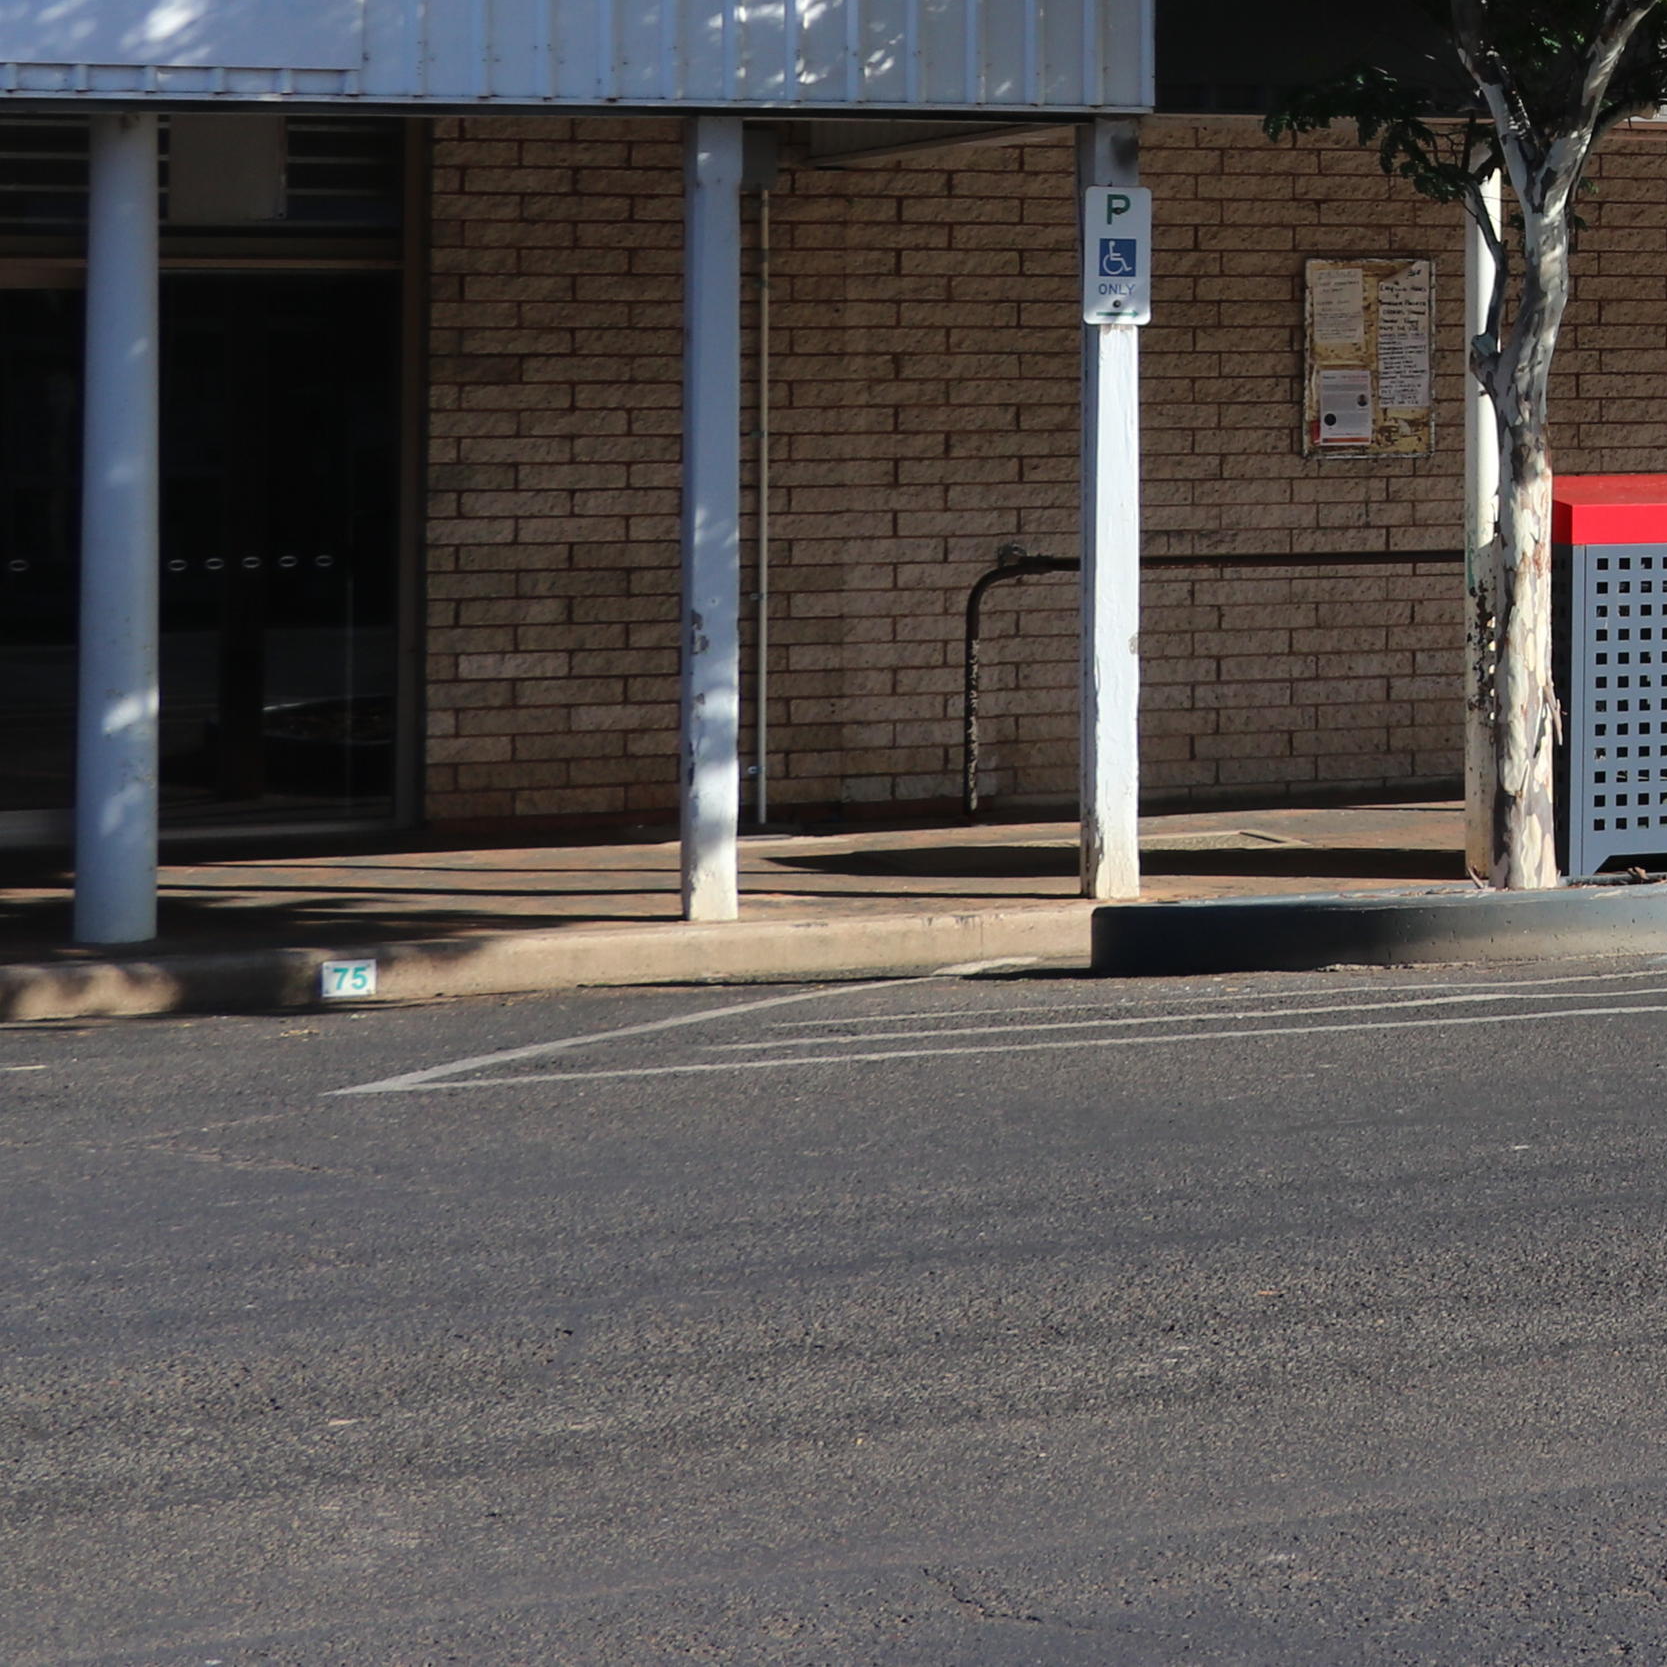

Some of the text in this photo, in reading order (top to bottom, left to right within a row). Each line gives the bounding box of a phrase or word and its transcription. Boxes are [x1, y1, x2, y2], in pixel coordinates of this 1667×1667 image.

[1106, 193, 1131, 225] P
[1098, 283, 1136, 295] ONLY
[333, 966, 368, 991] 75
